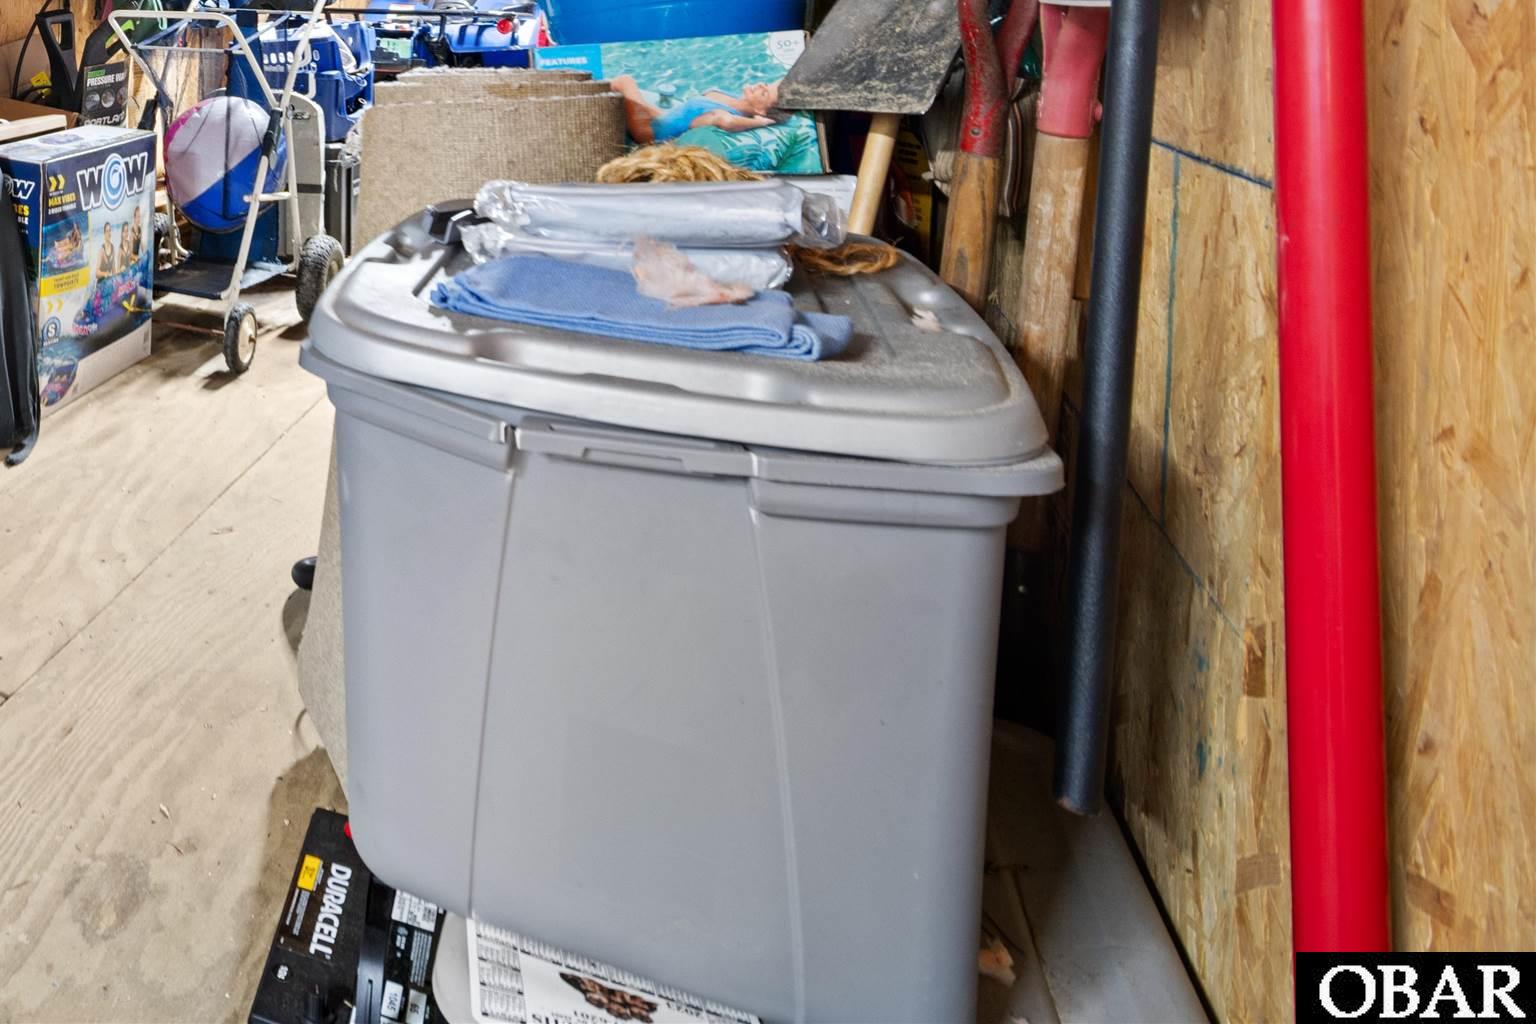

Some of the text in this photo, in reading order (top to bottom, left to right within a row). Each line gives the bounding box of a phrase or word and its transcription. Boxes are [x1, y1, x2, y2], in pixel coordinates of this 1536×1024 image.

[539, 55, 588, 66] FEATURES
[84, 110, 125, 126] PORTLAN
[76, 151, 149, 212] WOW
[48, 195, 62, 207] MAX
[47, 323, 56, 337] S
[309, 862, 353, 956] DURACELL
